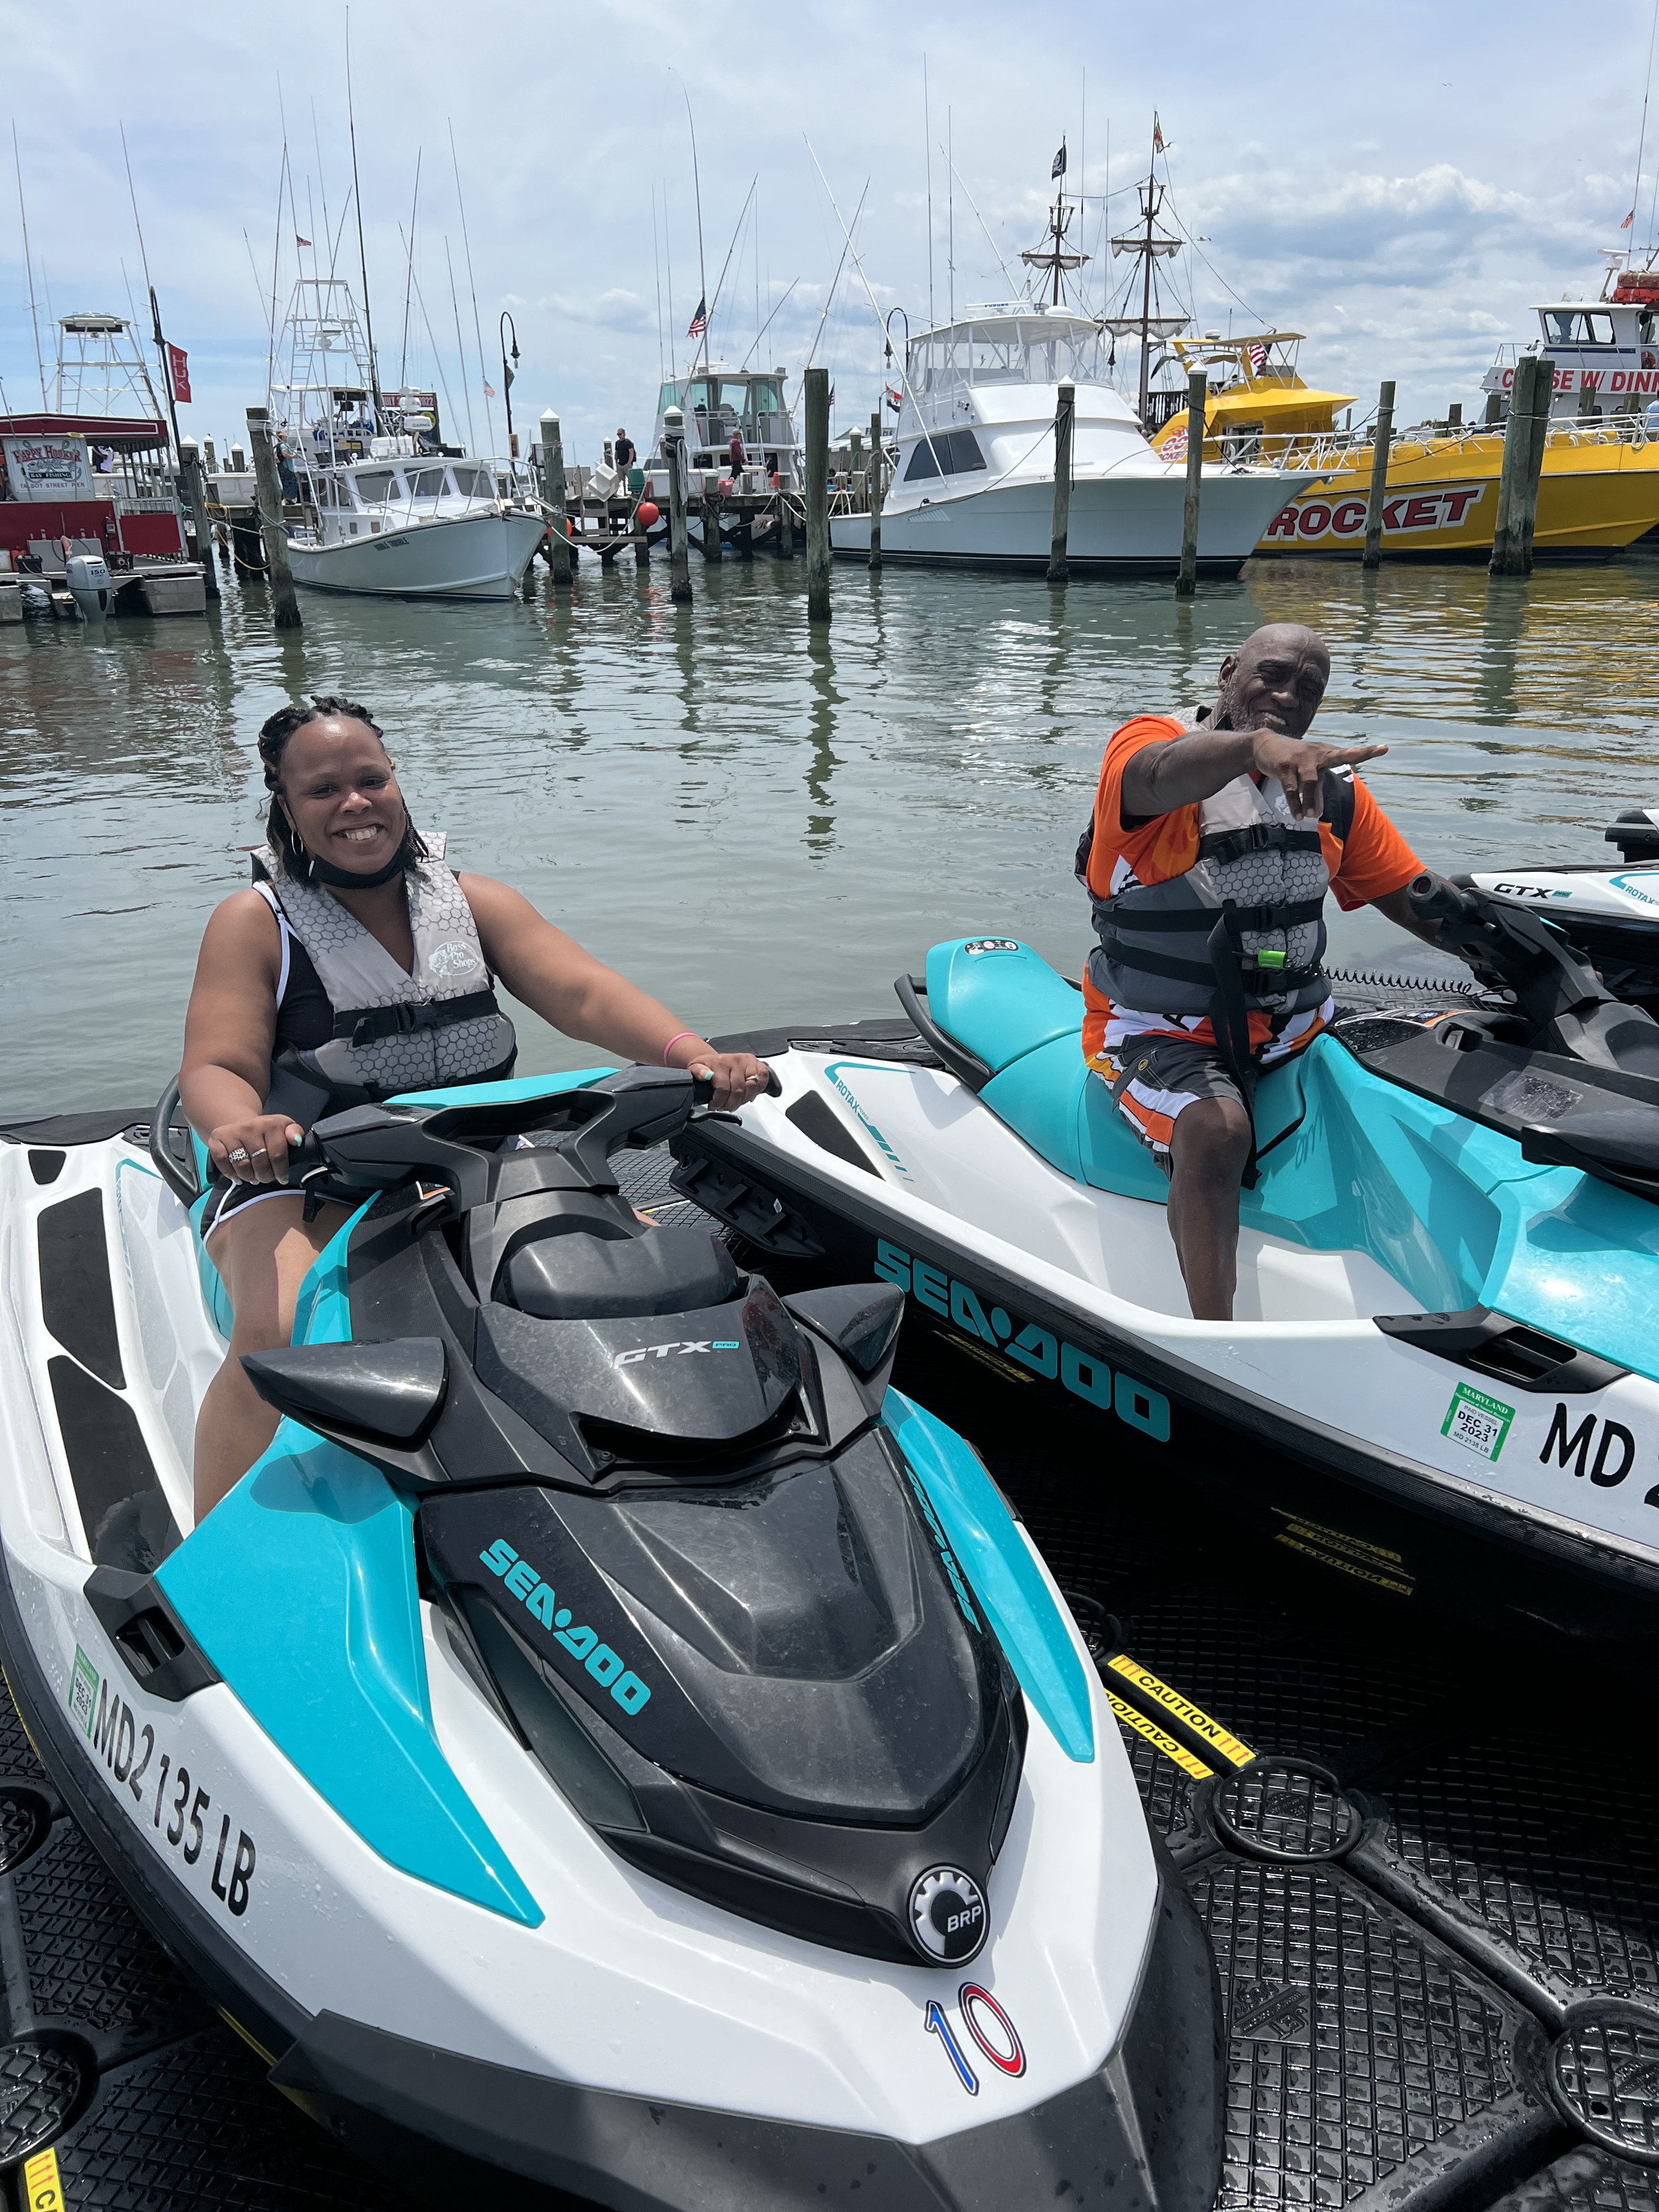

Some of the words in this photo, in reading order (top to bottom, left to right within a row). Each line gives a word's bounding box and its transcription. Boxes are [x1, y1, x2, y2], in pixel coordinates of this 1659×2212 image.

[1502, 369, 1575, 390] CSE
[43, 444, 82, 462] HOOKER
[1266, 489, 1481, 537] ROCKET
[1493, 883, 1554, 899] GTX
[1625, 885, 1655, 904] ROTAX
[446, 943, 466, 953] Bass
[450, 951, 464, 961] Pro
[453, 958, 476, 969] Shops
[836, 1079, 860, 1114] ROTAX
[613, 1340, 712, 1370] GTX
[1462, 1386, 1509, 1414] MARYLAND
[1458, 1410, 1482, 1428] DEC
[1483, 1424, 1498, 1437] 31
[1464, 1404, 1477, 1415] PAID
[1477, 1411, 1498, 1426] VESSEL
[1453, 1430, 1464, 1440] MD
[1464, 1436, 1480, 1448] 2138
[1480, 1444, 1489, 1453] LB
[1460, 1422, 1489, 1442] 2023
[1539, 1402, 1635, 1488] MD
[75, 1677, 86, 1698] DEC
[76, 1692, 88, 1716] 2023
[1138, 1675, 1222, 1739] CAUTION
[211, 1814, 256, 1917] LB
[947, 1904, 983, 1933] BRP
[923, 1981, 1028, 2097] 10
